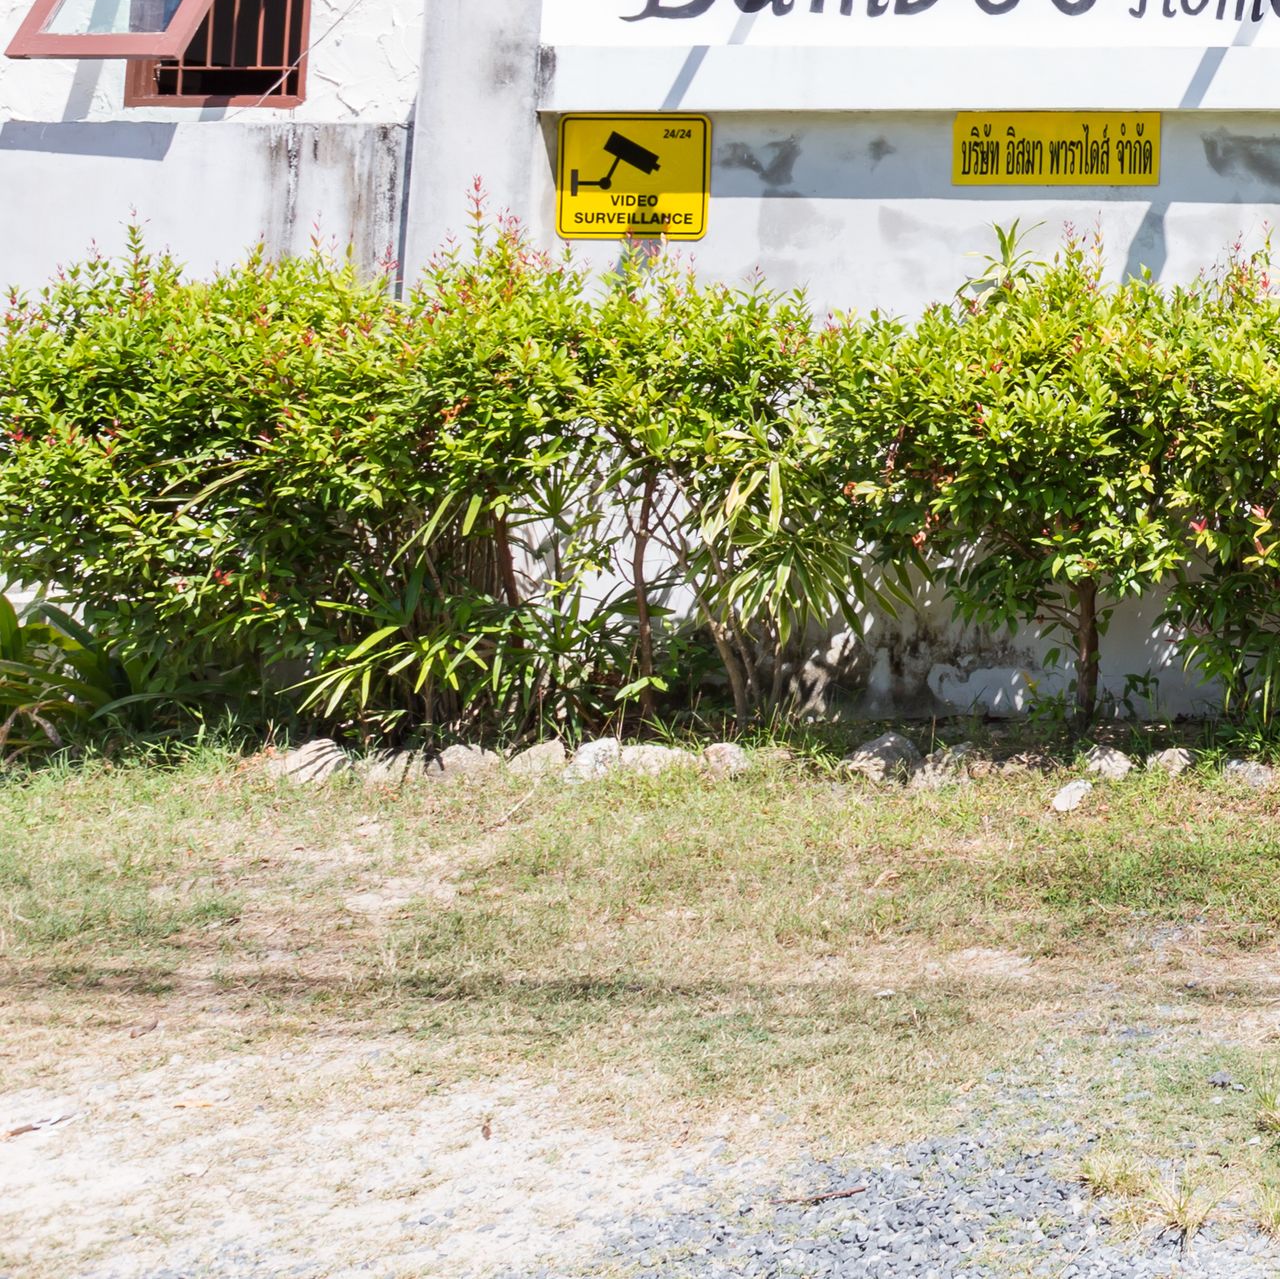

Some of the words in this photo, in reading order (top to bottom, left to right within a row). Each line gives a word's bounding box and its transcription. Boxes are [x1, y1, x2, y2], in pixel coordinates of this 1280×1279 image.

[663, 129, 692, 139] 24/24
[961, 124, 1000, 175] บริษัท
[1006, 126, 1043, 175] อิสมา
[1049, 123, 1110, 175] พาราไดส์
[1116, 123, 1153, 175] จำกัด
[610, 195, 658, 207] VIDEO
[574, 212, 693, 225] SURVEILLANCE
